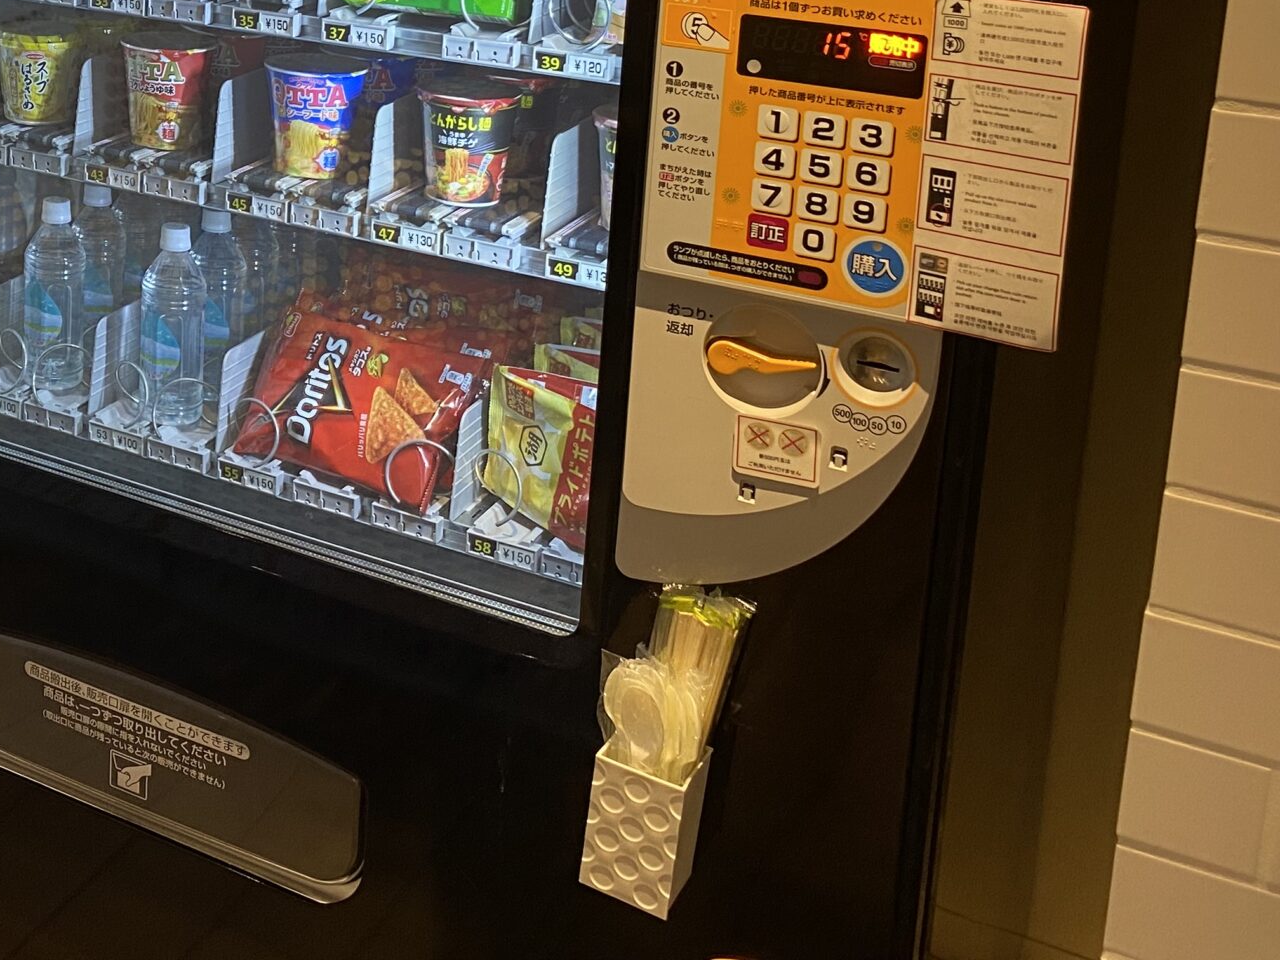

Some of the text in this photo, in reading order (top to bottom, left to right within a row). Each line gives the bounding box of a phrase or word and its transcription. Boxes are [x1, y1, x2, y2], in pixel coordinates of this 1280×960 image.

[239, 15, 288, 30] 35 ¥150
[947, 19, 965, 27] 1000
[329, 27, 383, 44] 37 ¥150
[823, 32, 851, 59] 15
[541, 56, 602, 74] 39 ¥120
[36, 60, 49, 93] スープ
[666, 78, 713, 90] 商品の番号を
[665, 87, 719, 100] 押してください
[749, 86, 906, 115] 押した商品番号が上に表示されます
[287, 109, 339, 121] シーフード味
[768, 109, 882, 148] 1 2 3
[680, 132, 709, 143] ボタンを
[661, 143, 715, 157] 押してください
[659, 163, 711, 178] まちがえた時は
[761, 147, 879, 187] 4 5 6
[112, 173, 136, 186] ¥150
[674, 175, 704, 186] ボタンを
[658, 182, 711, 196] 押してやり直し
[658, 191, 694, 201] てください
[232, 198, 282, 216] 45 ¥150
[758, 183, 876, 224] 7 8 9
[378, 228, 433, 247] 47 ¥130
[750, 222, 785, 244] 訂正
[801, 229, 825, 252] 0
[553, 264, 573, 276] 49
[850, 252, 898, 283] 購入
[666, 321, 693, 336] 返却
[286, 337, 348, 444] Doritos
[834, 409, 902, 431] 500 100 50 10
[117, 436, 138, 449] ¥100
[554, 415, 594, 525] プライドポテト
[248, 475, 274, 490] ¥150
[474, 540, 532, 564] 58 ¥150
[30, 665, 246, 755] 商品搬出後、販売口扉を開くことができます
